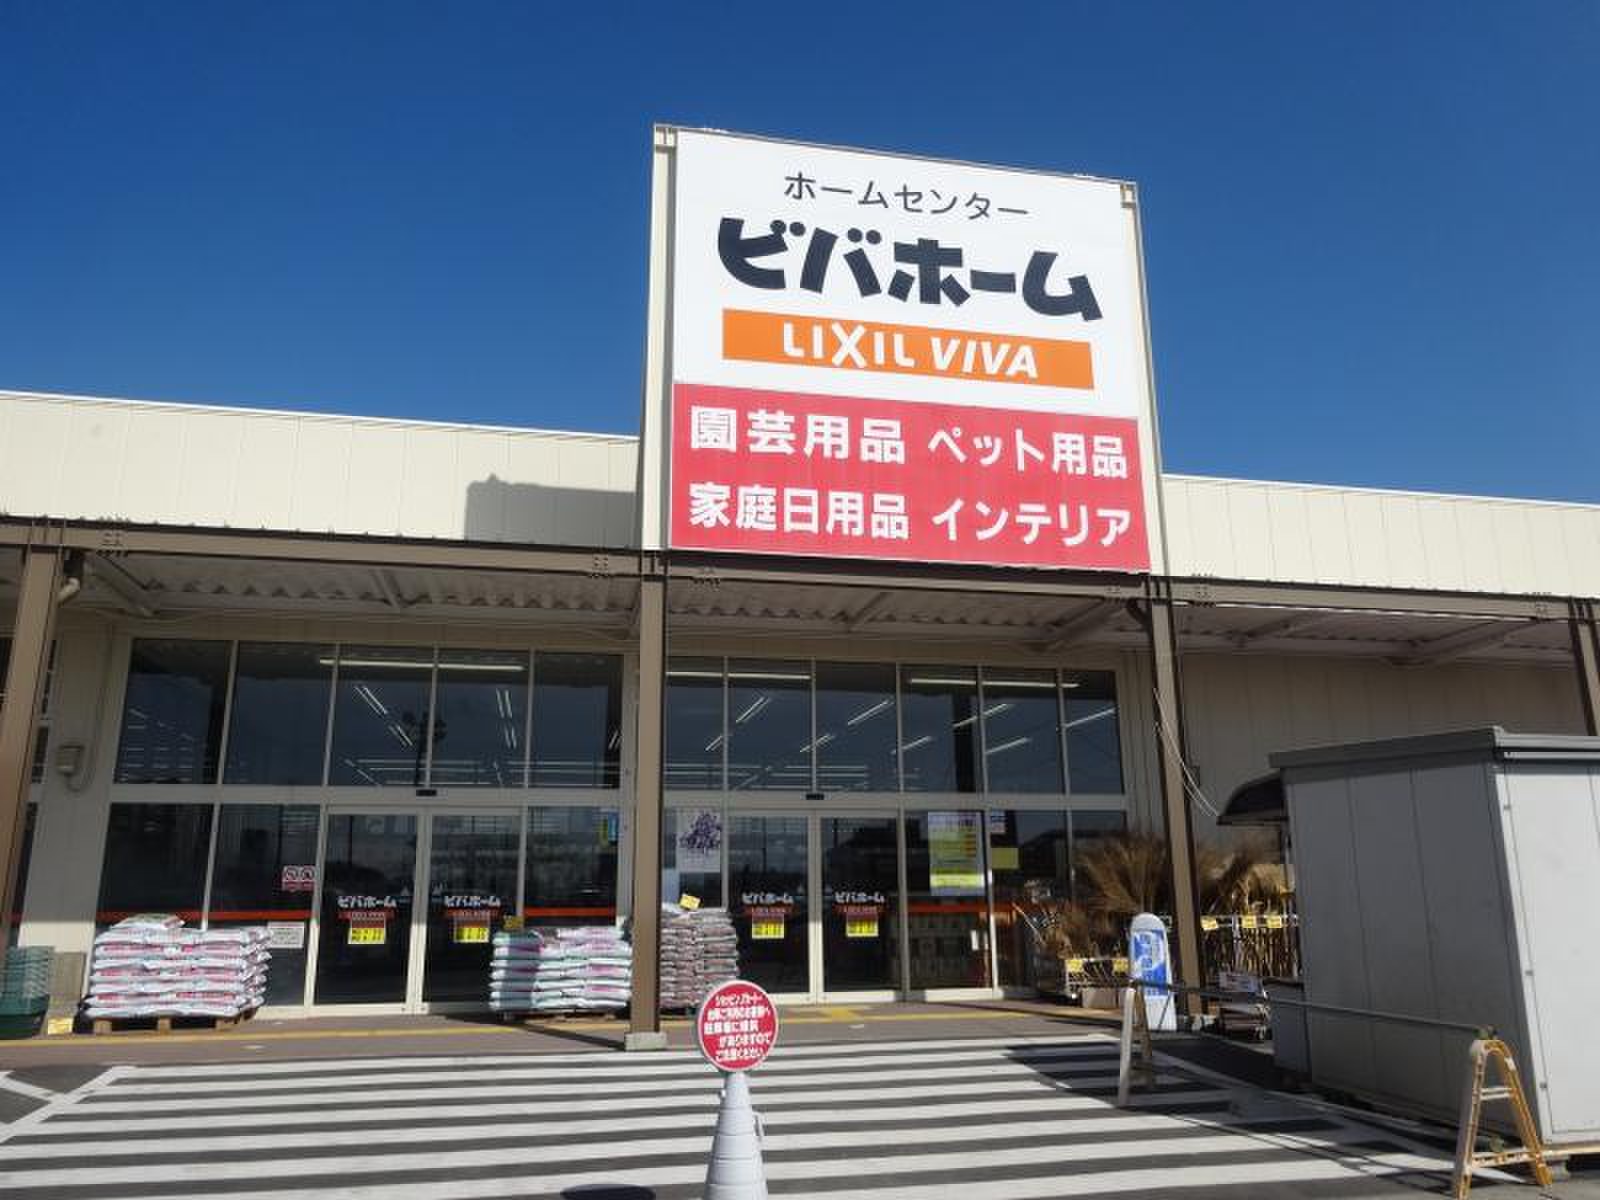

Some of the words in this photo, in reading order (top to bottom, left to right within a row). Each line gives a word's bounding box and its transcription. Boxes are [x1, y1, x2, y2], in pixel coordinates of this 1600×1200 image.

[784, 171, 1029, 220] ホームセンター
[717, 216, 1103, 322] ビバホーム
[783, 321, 917, 369] LIXIL
[930, 336, 1039, 380] VIVA
[690, 405, 906, 465] 園芸用品
[927, 426, 1128, 479] ペット用品
[689, 482, 909, 541] 家庭日用品
[931, 497, 1131, 547] インテリア
[337, 895, 397, 909] ビバホーム
[444, 895, 501, 908] ビバホーム
[742, 891, 794, 905] ビバホーム
